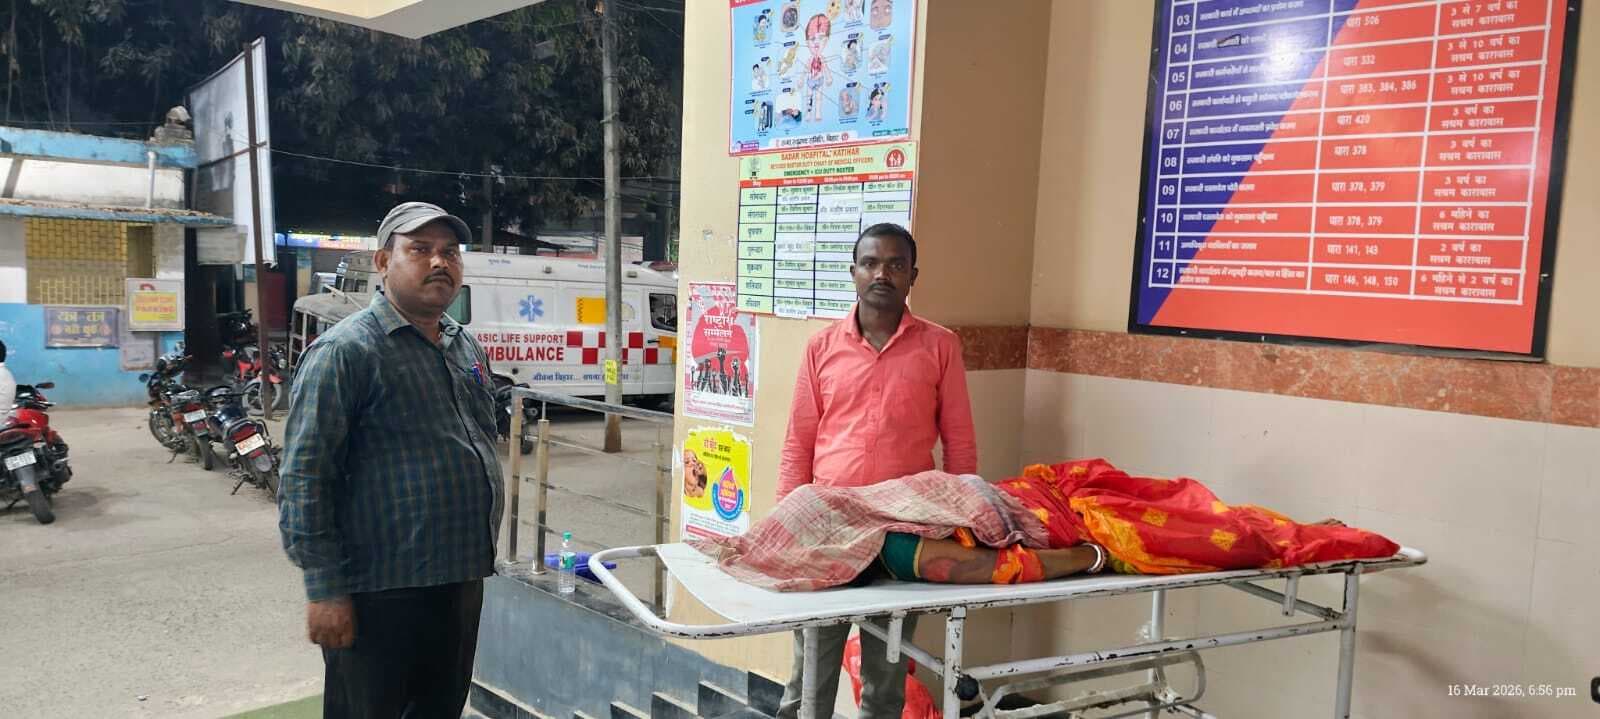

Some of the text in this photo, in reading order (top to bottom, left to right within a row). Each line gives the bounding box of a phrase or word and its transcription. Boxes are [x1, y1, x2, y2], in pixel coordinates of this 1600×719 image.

[1177, 16, 1190, 26] 03
[1364, 16, 1380, 26] 506
[1175, 44, 1187, 54] 04
[1473, 40, 1484, 48] 10
[1172, 73, 1185, 82] 05
[1473, 73, 1484, 81] 10
[1170, 101, 1182, 111] 06
[1167, 129, 1179, 139] 07
[833, 148, 859, 156] KATIHAR
[1165, 157, 1177, 168] 08
[784, 168, 810, 176] EMERGENCY
[1162, 185, 1174, 195] 09
[1161, 213, 1173, 223] 10
[1159, 241, 1170, 250] 11
[1157, 268, 1169, 278] 12
[502, 334, 519, 343] LIFE
[524, 334, 564, 344] SUPPORT
[485, 347, 564, 361] MBULANCE
